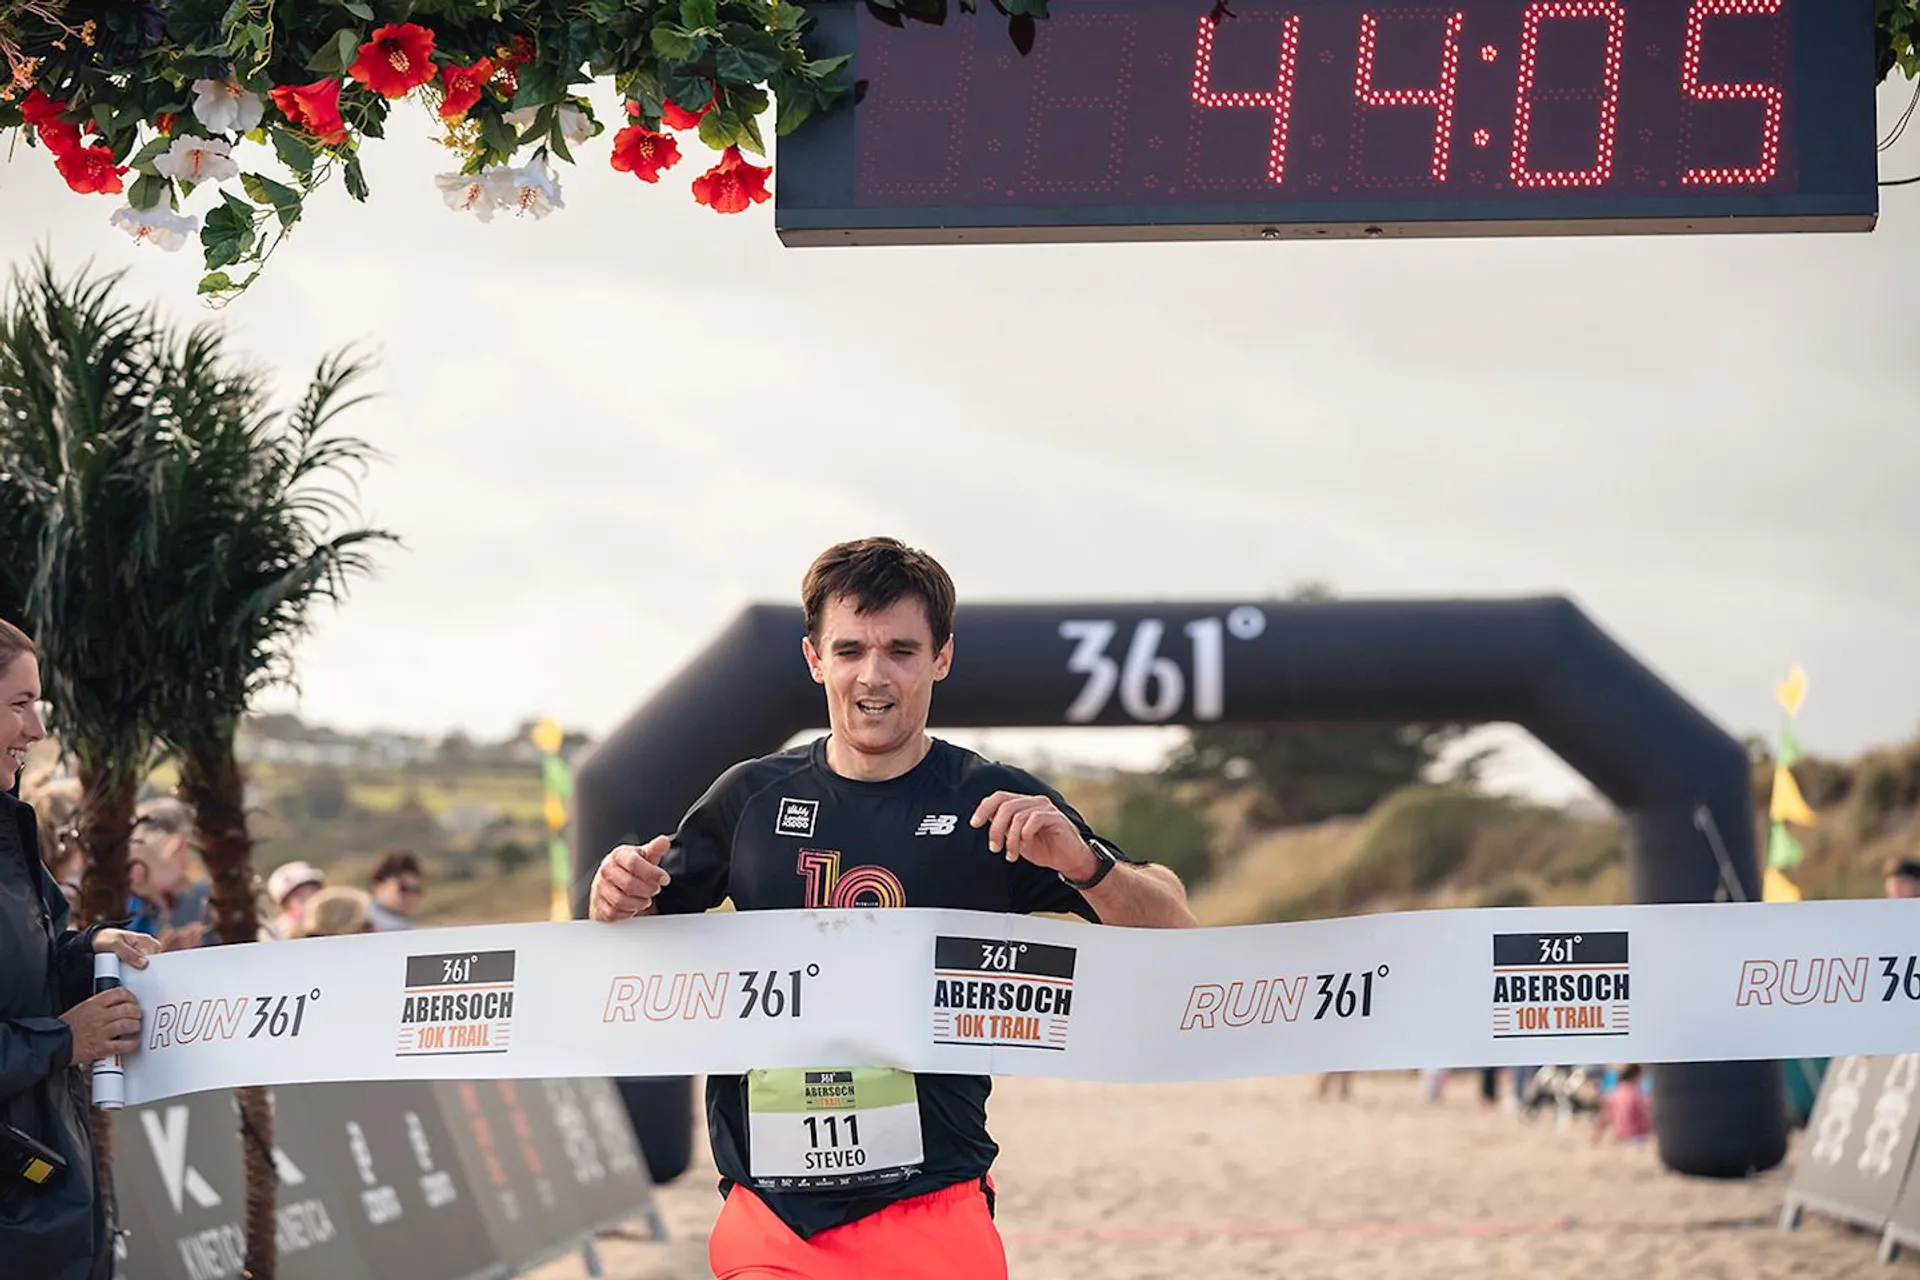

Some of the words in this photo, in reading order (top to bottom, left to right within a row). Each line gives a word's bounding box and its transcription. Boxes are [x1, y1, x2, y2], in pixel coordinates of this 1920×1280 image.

[1192, 0, 1782, 187] 44:05
[1058, 605, 1267, 724] 361°
[979, 943, 1028, 971] 361°
[1538, 934, 1582, 963] 361°
[441, 954, 479, 983] 361°
[1736, 957, 1869, 1006] RUN
[1878, 955, 1920, 1002] 36
[602, 971, 730, 1023] RUN
[738, 963, 820, 1019] 361°
[934, 979, 1073, 1016] ABERSOCH
[1180, 975, 1308, 1030] RUN
[1313, 964, 1390, 1020] 361°
[1493, 973, 1630, 1003] ABERSOCH
[149, 997, 248, 1050] RUN
[248, 987, 321, 1039] 361°
[401, 991, 514, 1024] ABERSOCH
[1516, 1006, 1550, 1030] 10K
[1553, 1005, 1605, 1029] TRAIL
[417, 1026, 446, 1049] 10K
[448, 1023, 489, 1048] TRAIL
[954, 1012, 985, 1038] 10K
[989, 1014, 1041, 1041] TRAIL
[805, 1085, 855, 1097] ABERSOCH
[803, 1114, 860, 1149] 111
[805, 1148, 867, 1170] STEVEO
